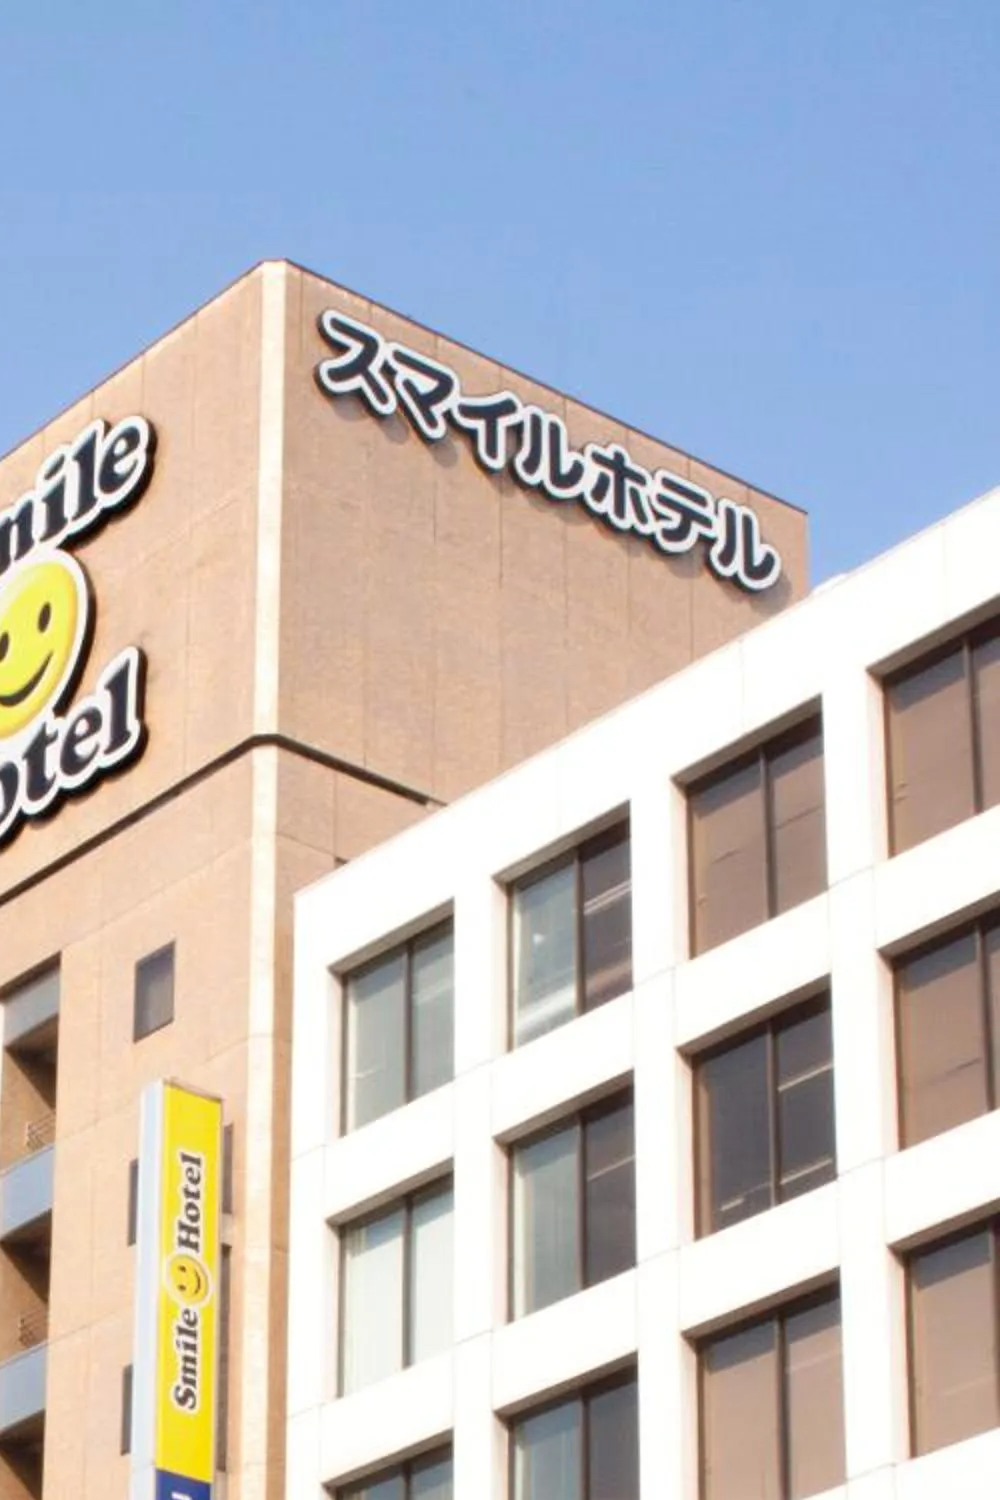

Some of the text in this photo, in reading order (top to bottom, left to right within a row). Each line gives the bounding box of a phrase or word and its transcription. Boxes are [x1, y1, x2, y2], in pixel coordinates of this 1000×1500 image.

[323, 312, 780, 587] スマイルホテル
[173, 1152, 203, 1411] Smile Hotel
